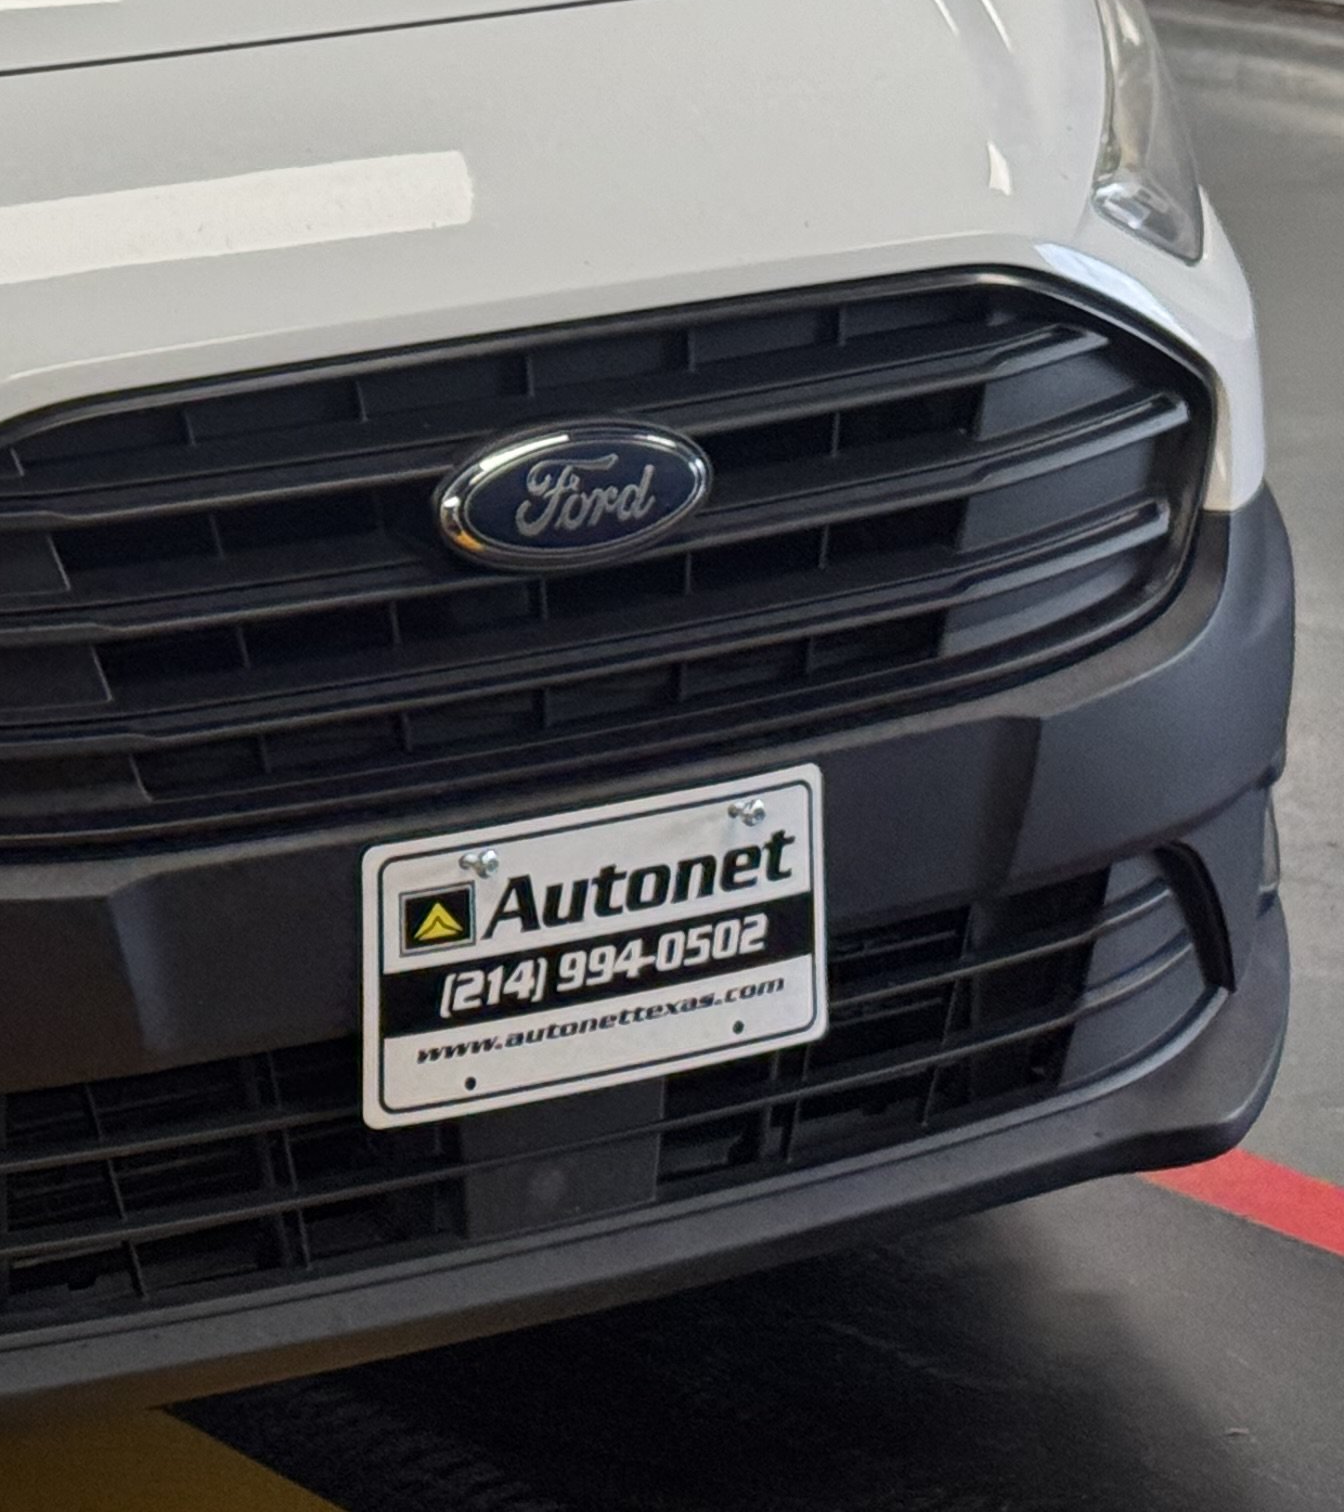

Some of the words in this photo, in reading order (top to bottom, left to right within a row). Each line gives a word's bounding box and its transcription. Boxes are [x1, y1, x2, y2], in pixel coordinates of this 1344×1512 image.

[516, 453, 655, 536] Ford
[482, 830, 795, 940] Autonet
[440, 959, 547, 1018] (214)
[556, 913, 768, 990] 994-0502
[417, 977, 785, 1065] www.autonettexas.com
